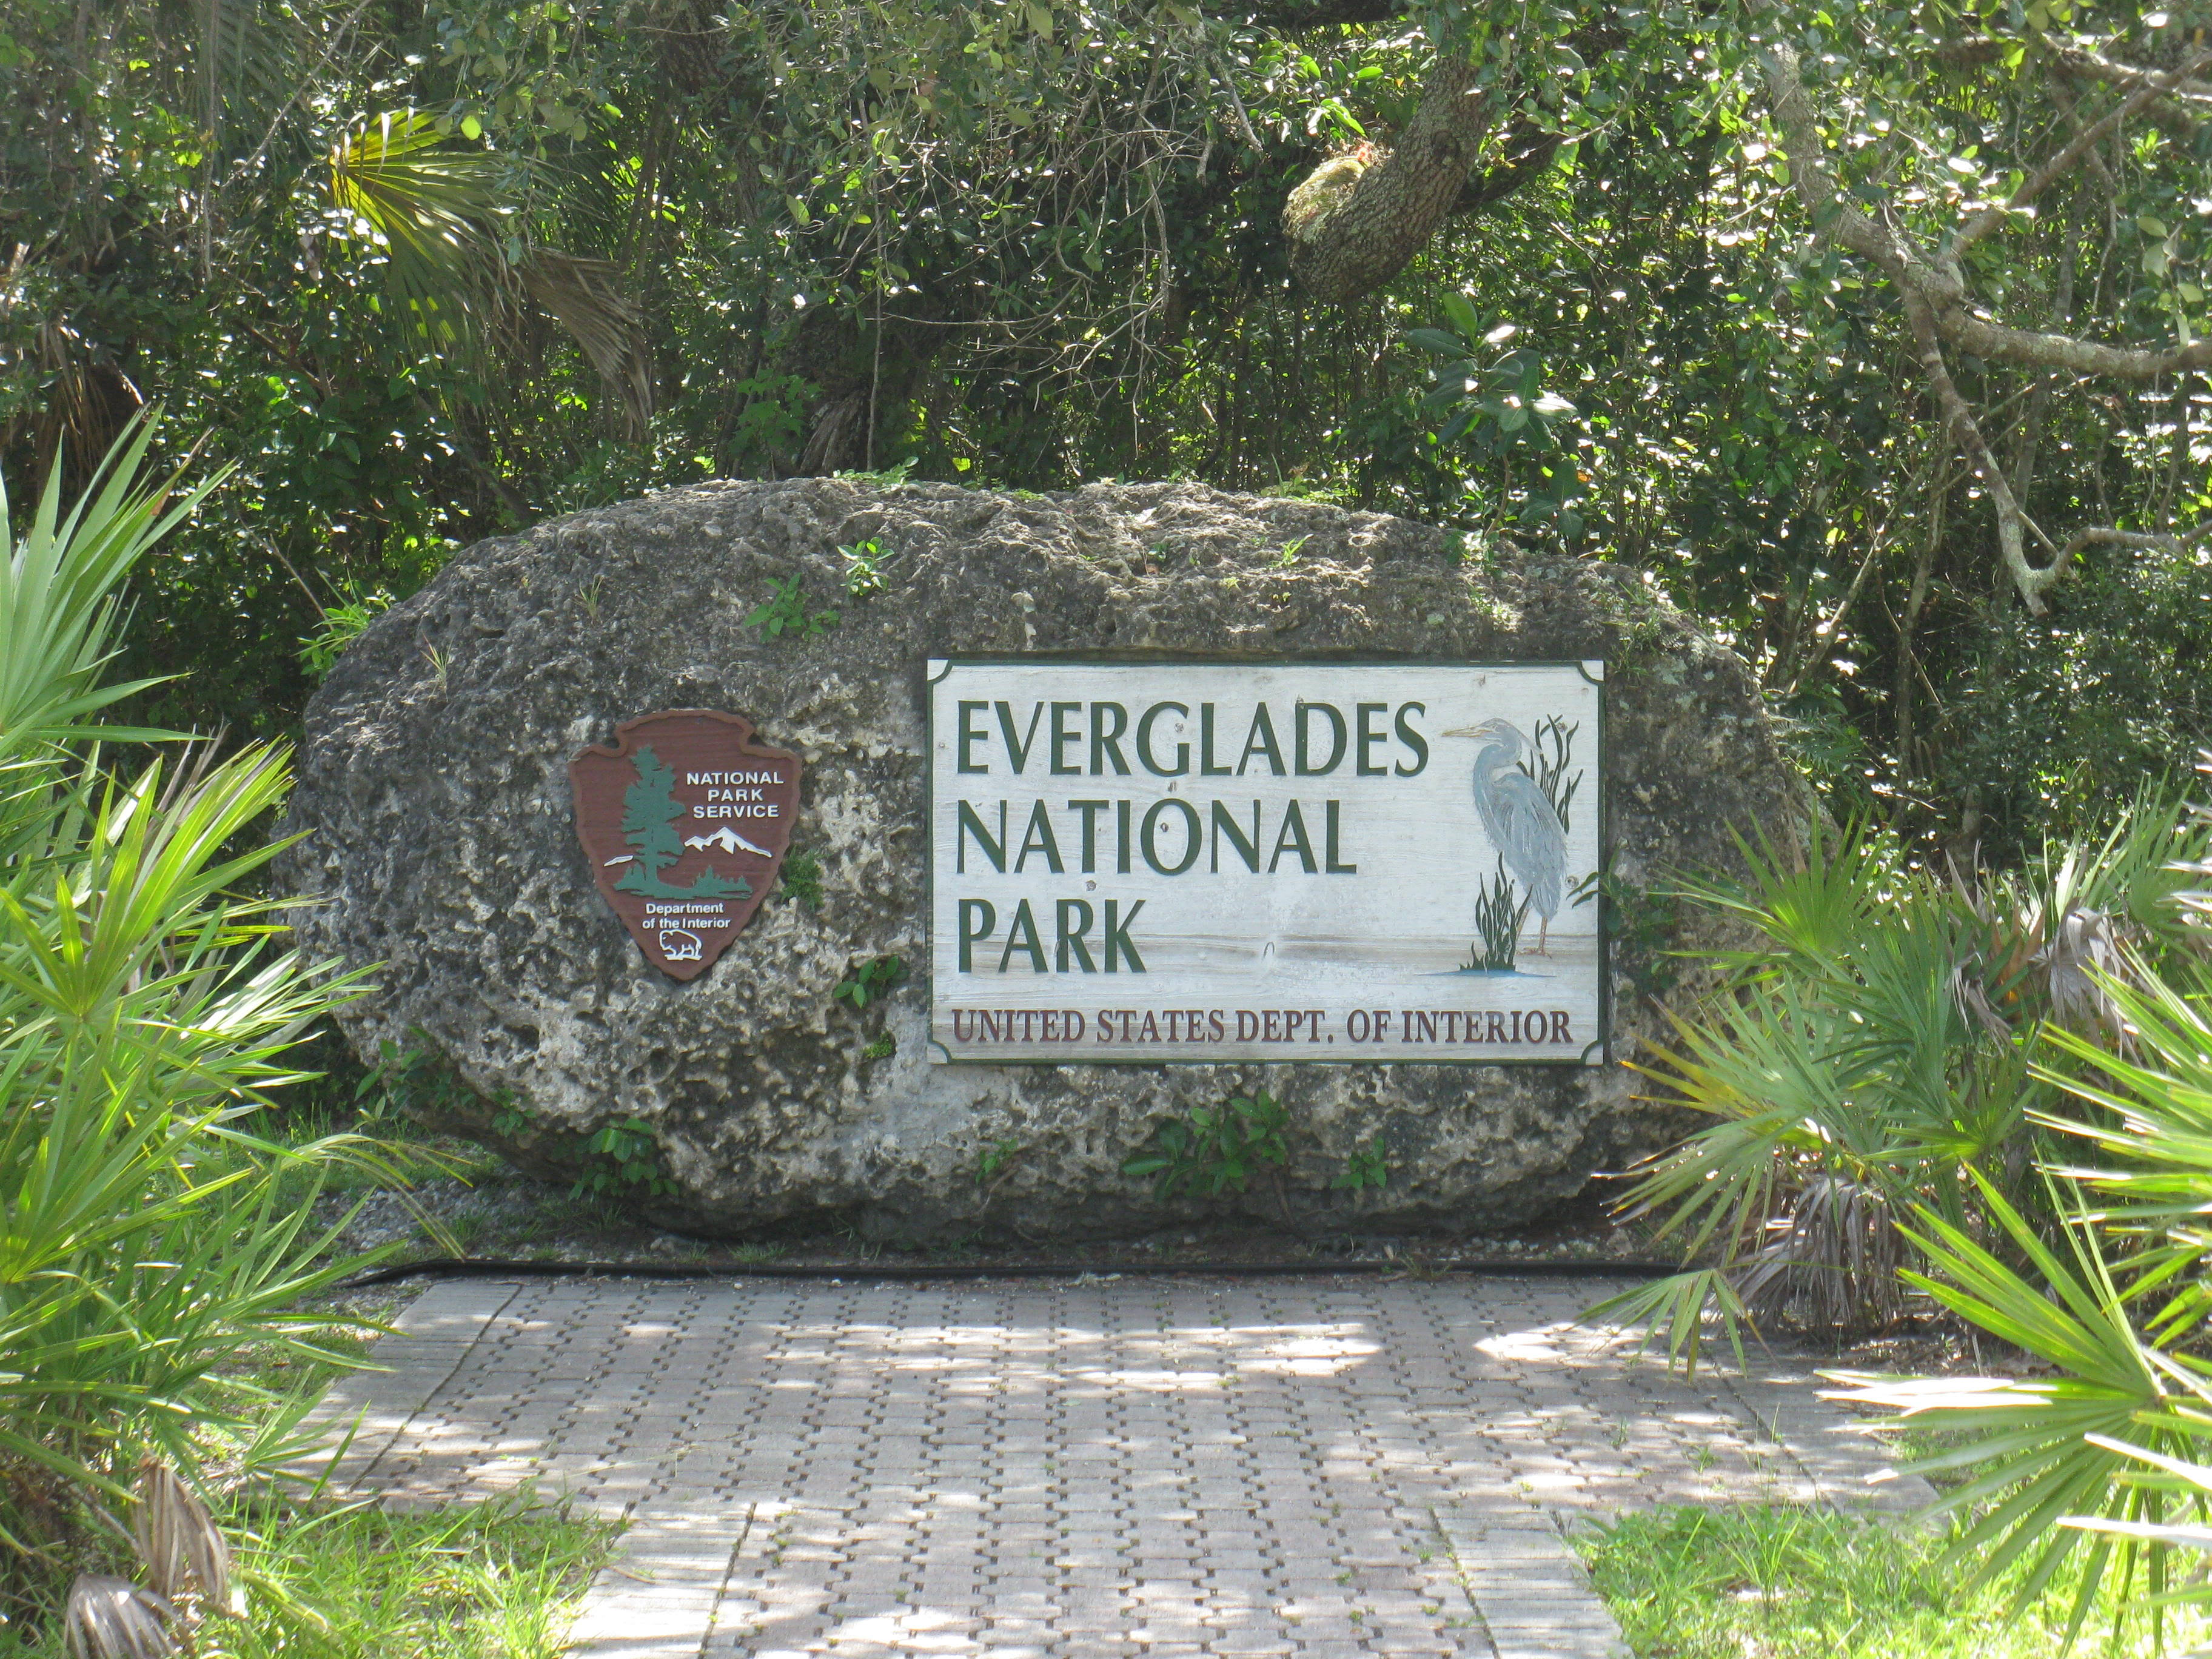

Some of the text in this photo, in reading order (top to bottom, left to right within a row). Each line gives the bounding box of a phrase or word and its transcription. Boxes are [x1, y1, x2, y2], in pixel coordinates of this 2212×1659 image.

[957, 700, 1429, 777] EVERGLADES
[686, 771, 784, 785] NATIONAL
[708, 789, 763, 802] PARK
[693, 805, 779, 819] SERVICE
[956, 798, 1357, 876] NATIONAL
[645, 902, 724, 916] Department
[642, 917, 731, 930] of the Interior
[957, 898, 1147, 973] PARK
[953, 1009, 1574, 1044] UNITED STATES DEPT. OF INTERIOR
